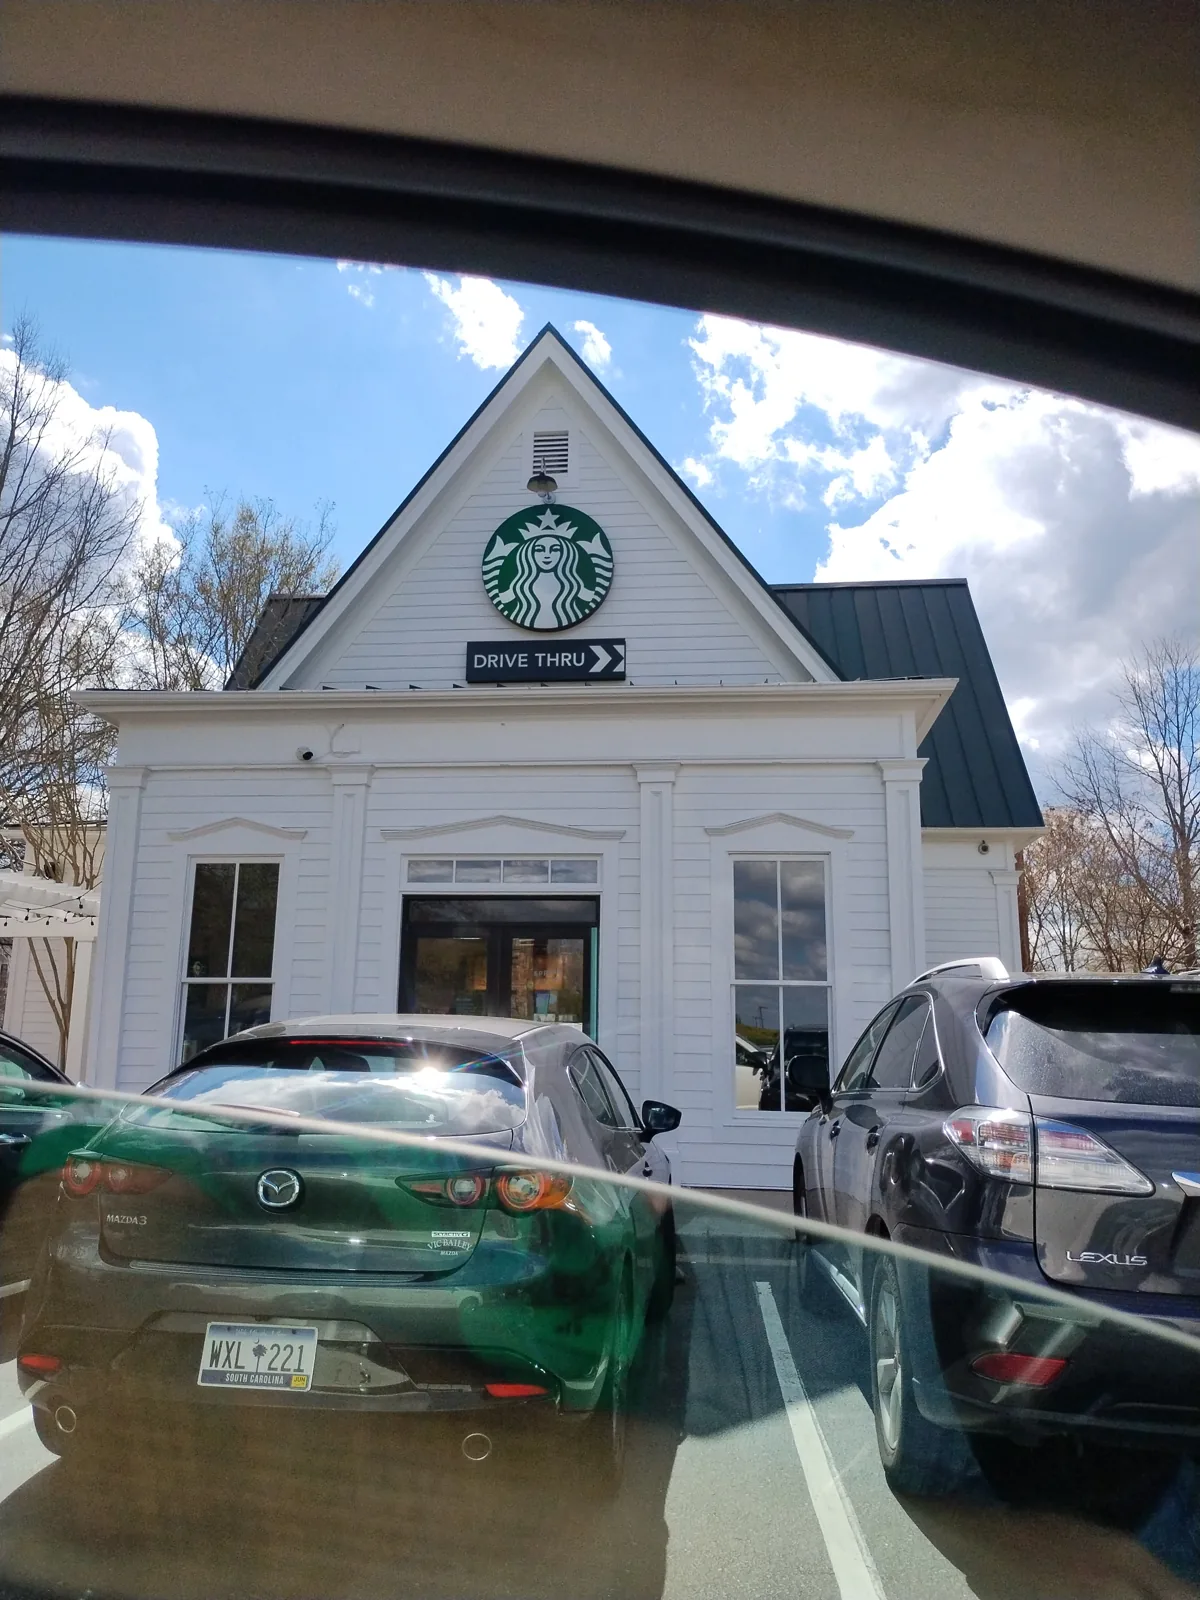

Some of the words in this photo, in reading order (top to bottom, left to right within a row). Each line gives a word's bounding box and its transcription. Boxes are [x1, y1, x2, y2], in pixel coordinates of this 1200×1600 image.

[474, 653, 529, 668] DRIVE
[535, 652, 585, 667] THRU
[427, 1240, 442, 1249] VIC
[442, 1239, 472, 1251] BAILEY
[1066, 1250, 1148, 1266] LEXUS
[209, 1340, 245, 1370] WXL
[267, 1343, 305, 1373] 221
[225, 1373, 248, 1382] SOUTH
[250, 1374, 284, 1384] CAROLINA
